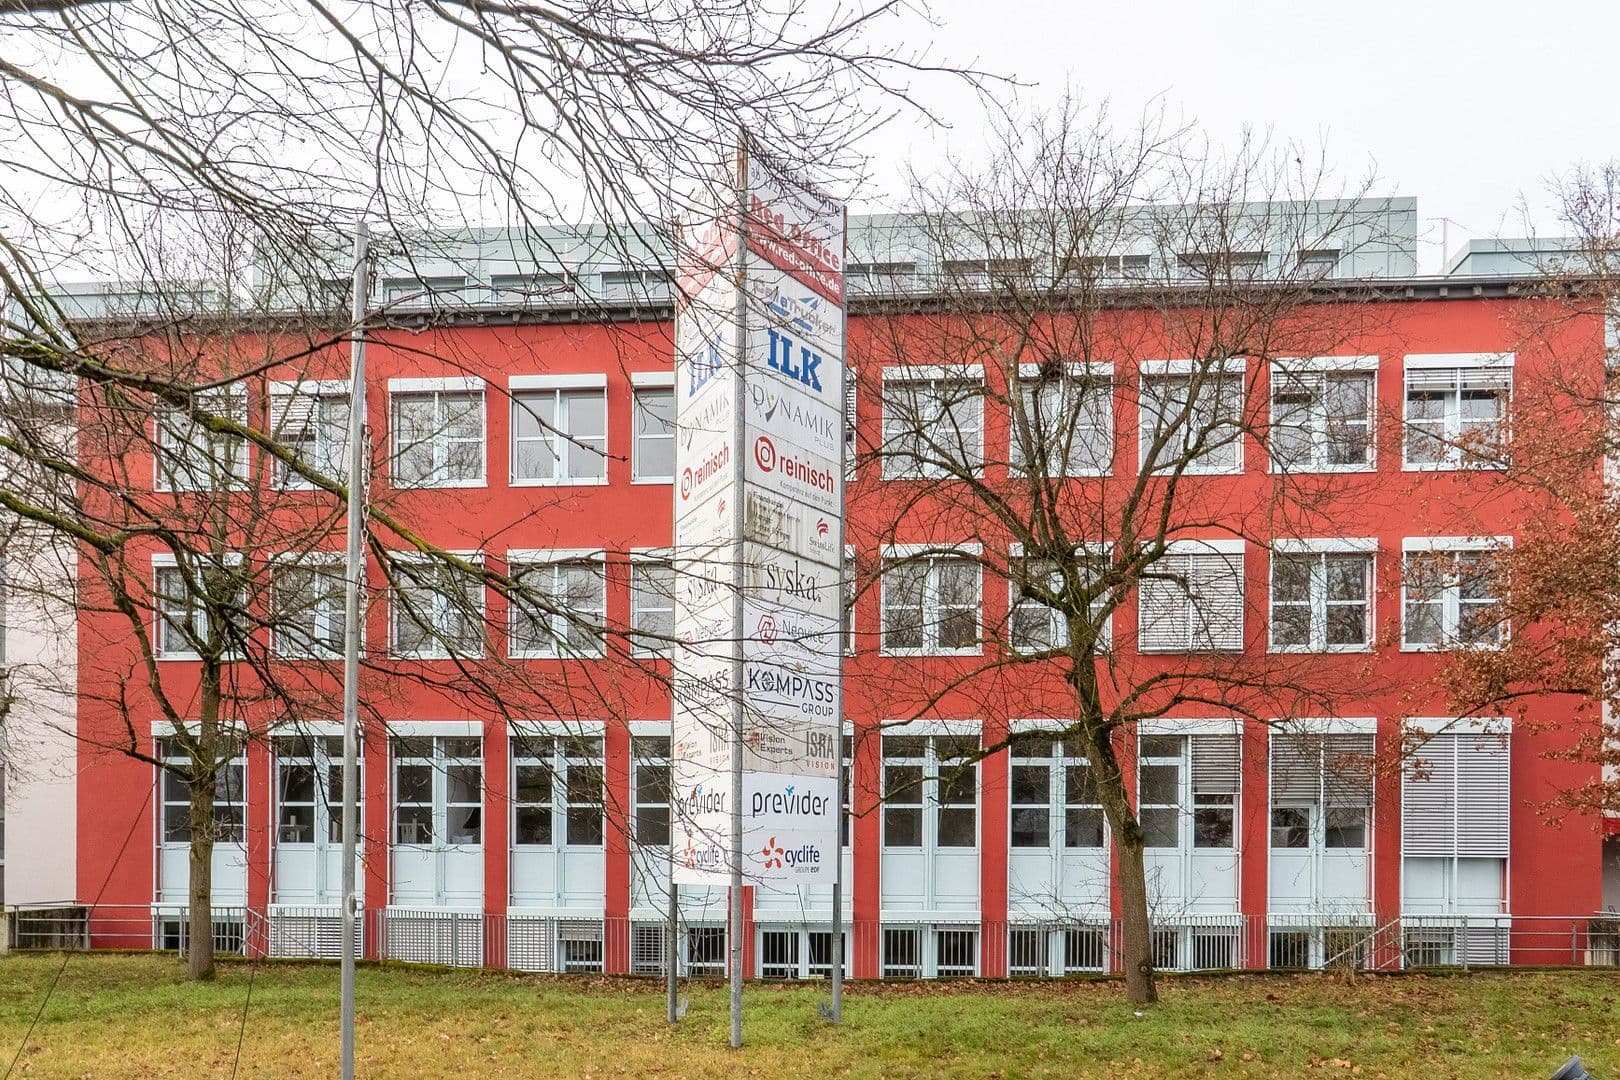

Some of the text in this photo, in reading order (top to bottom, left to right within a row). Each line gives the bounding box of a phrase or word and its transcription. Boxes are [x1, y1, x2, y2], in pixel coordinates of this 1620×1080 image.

[767, 328, 822, 393] ILK
[694, 441, 729, 489] reinisch
[780, 455, 834, 494] reinisch
[749, 668, 834, 703] KOMPASS
[801, 702, 834, 718] GROUP
[760, 743, 793, 755] Experts
[806, 731, 834, 760] ISRA
[806, 760, 835, 770] VISION
[752, 790, 829, 818] previder
[785, 845, 820, 867] cyclife
